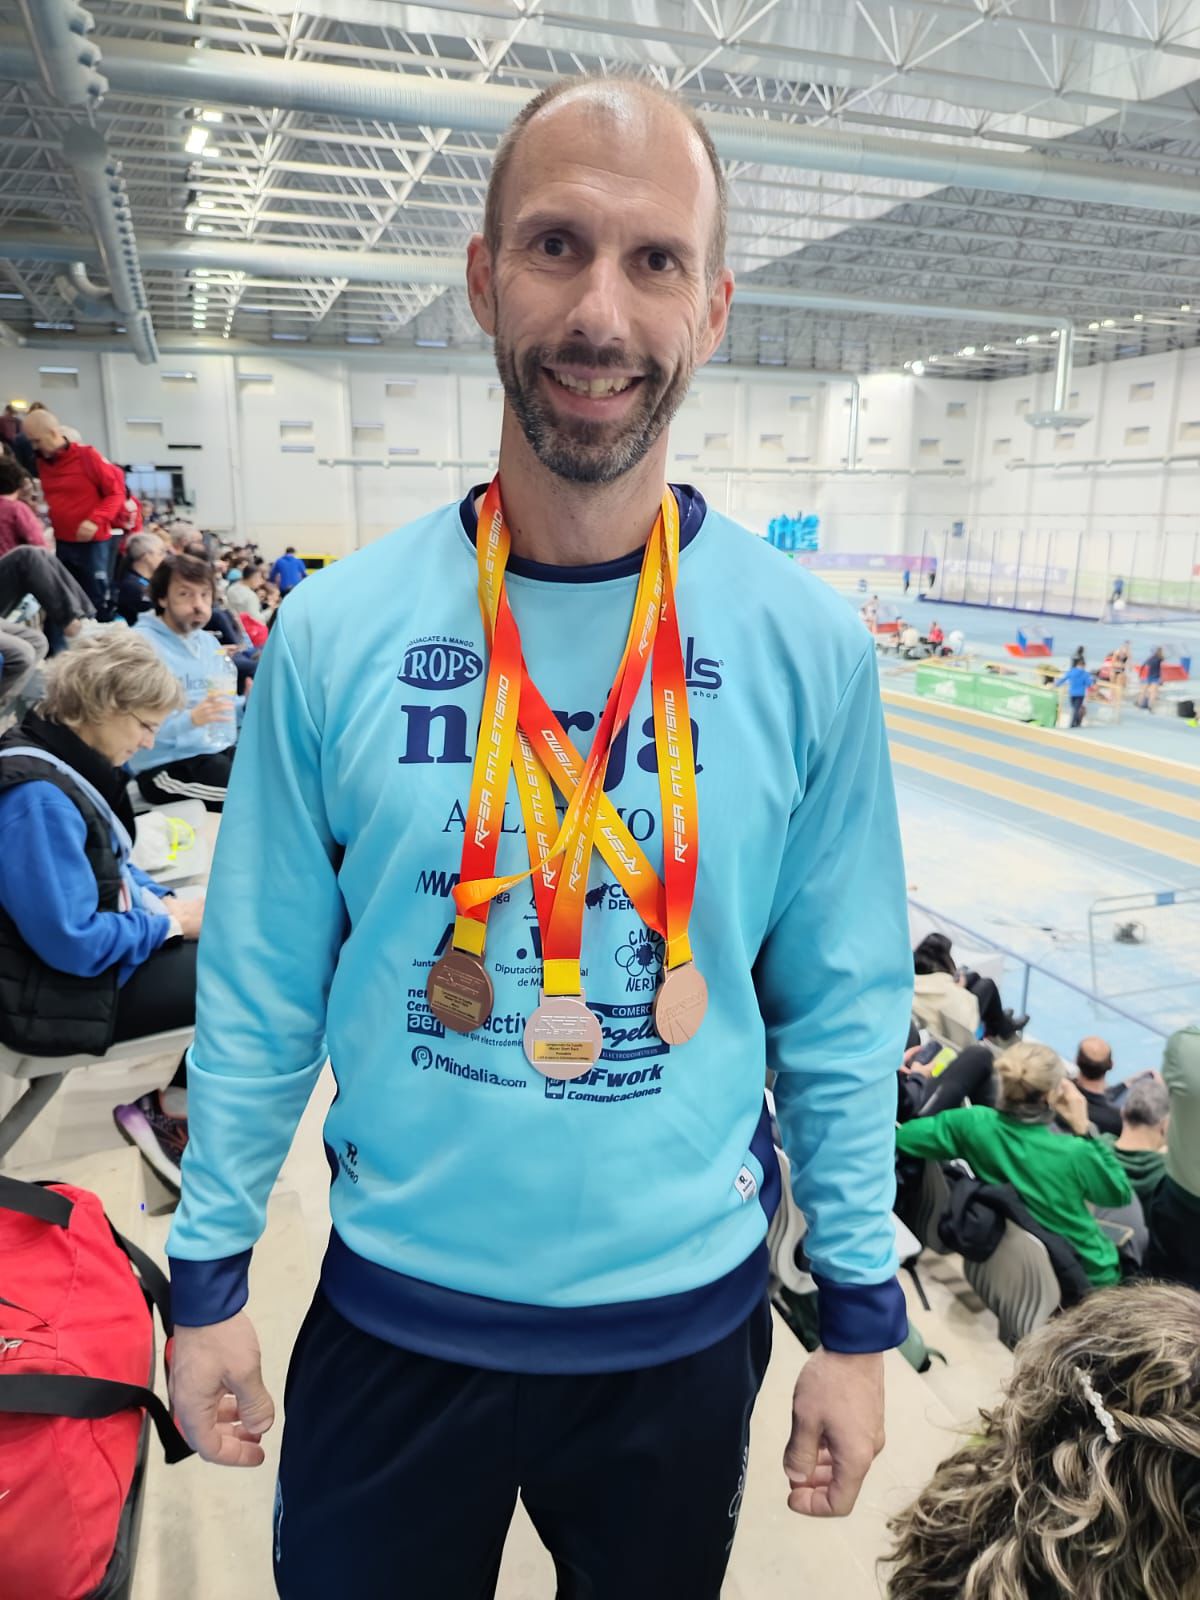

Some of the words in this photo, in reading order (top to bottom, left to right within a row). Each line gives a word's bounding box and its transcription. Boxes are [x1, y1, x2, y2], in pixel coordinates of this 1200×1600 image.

[485, 674, 509, 785] ATLETISMO
[664, 689, 683, 799] ATLETISMO
[435, 1054, 527, 1089] Mindalia.com
[567, 1086, 663, 1103] Comunicaciones
